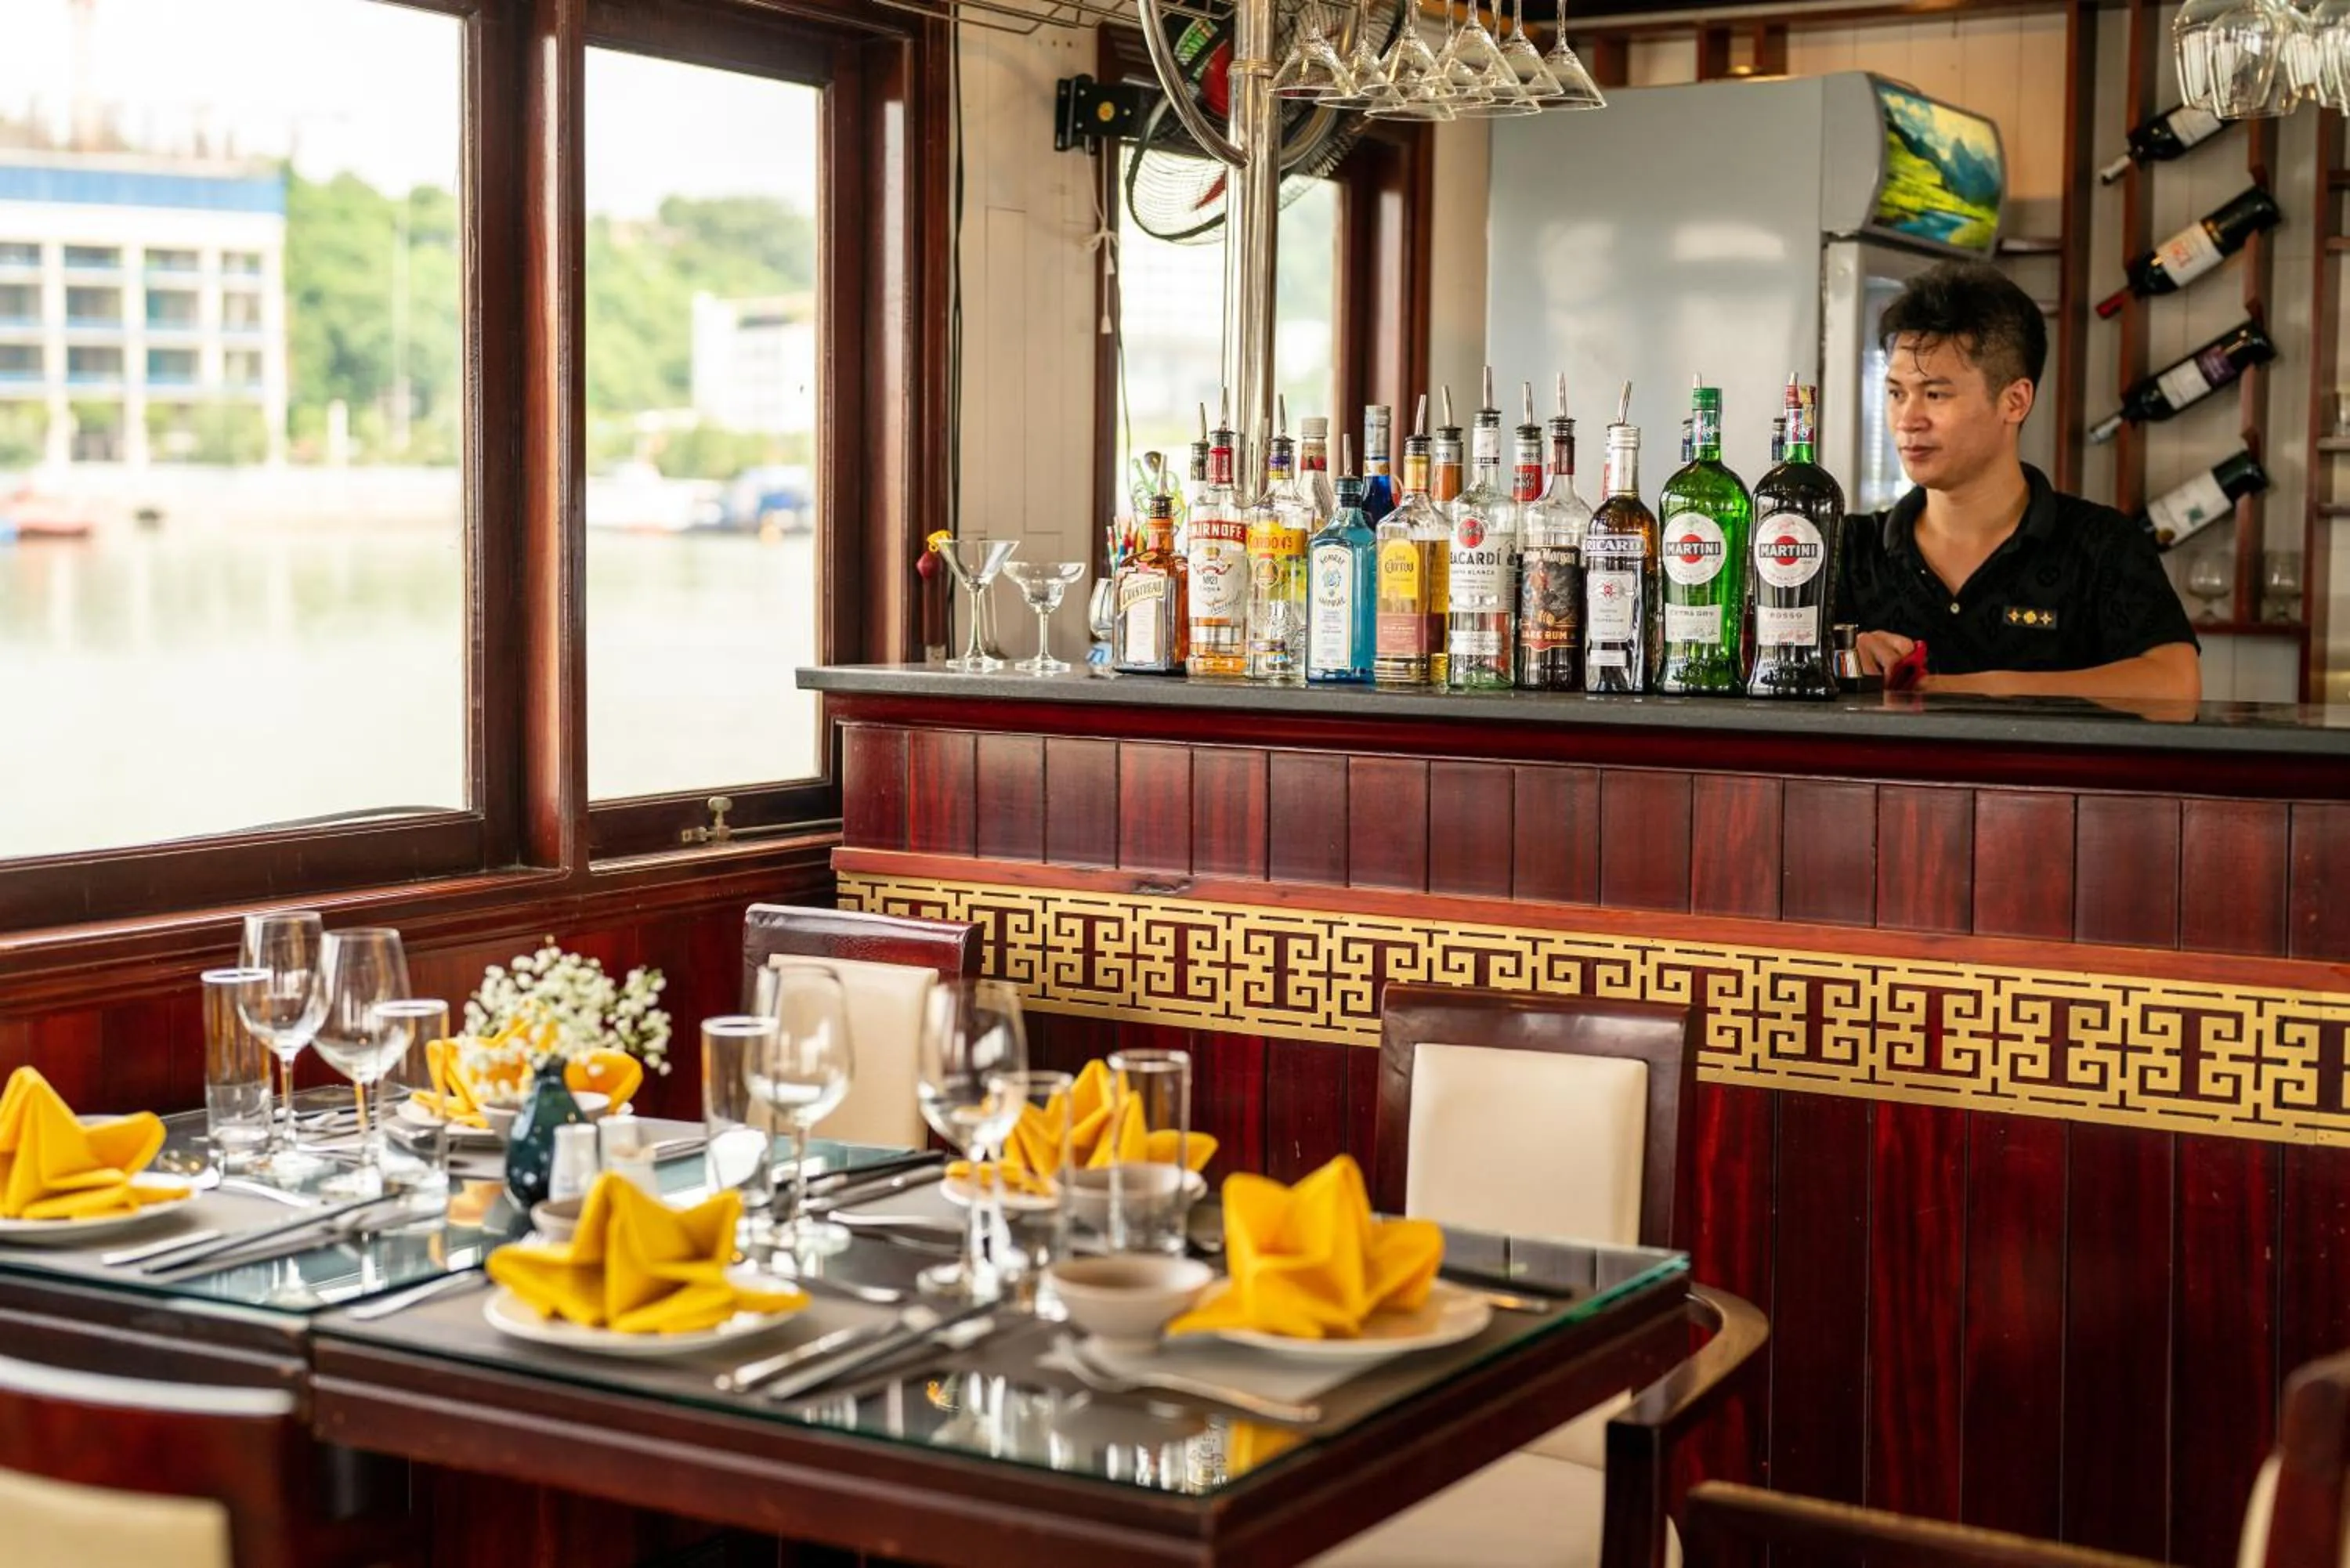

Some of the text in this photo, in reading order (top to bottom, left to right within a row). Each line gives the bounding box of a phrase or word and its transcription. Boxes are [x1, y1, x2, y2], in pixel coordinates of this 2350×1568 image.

[1586, 538, 1643, 551] RICARD
[1666, 542, 1720, 555] MARTINI
[1760, 544, 1817, 558] MARTINI
[1544, 630, 1567, 640] RUM
